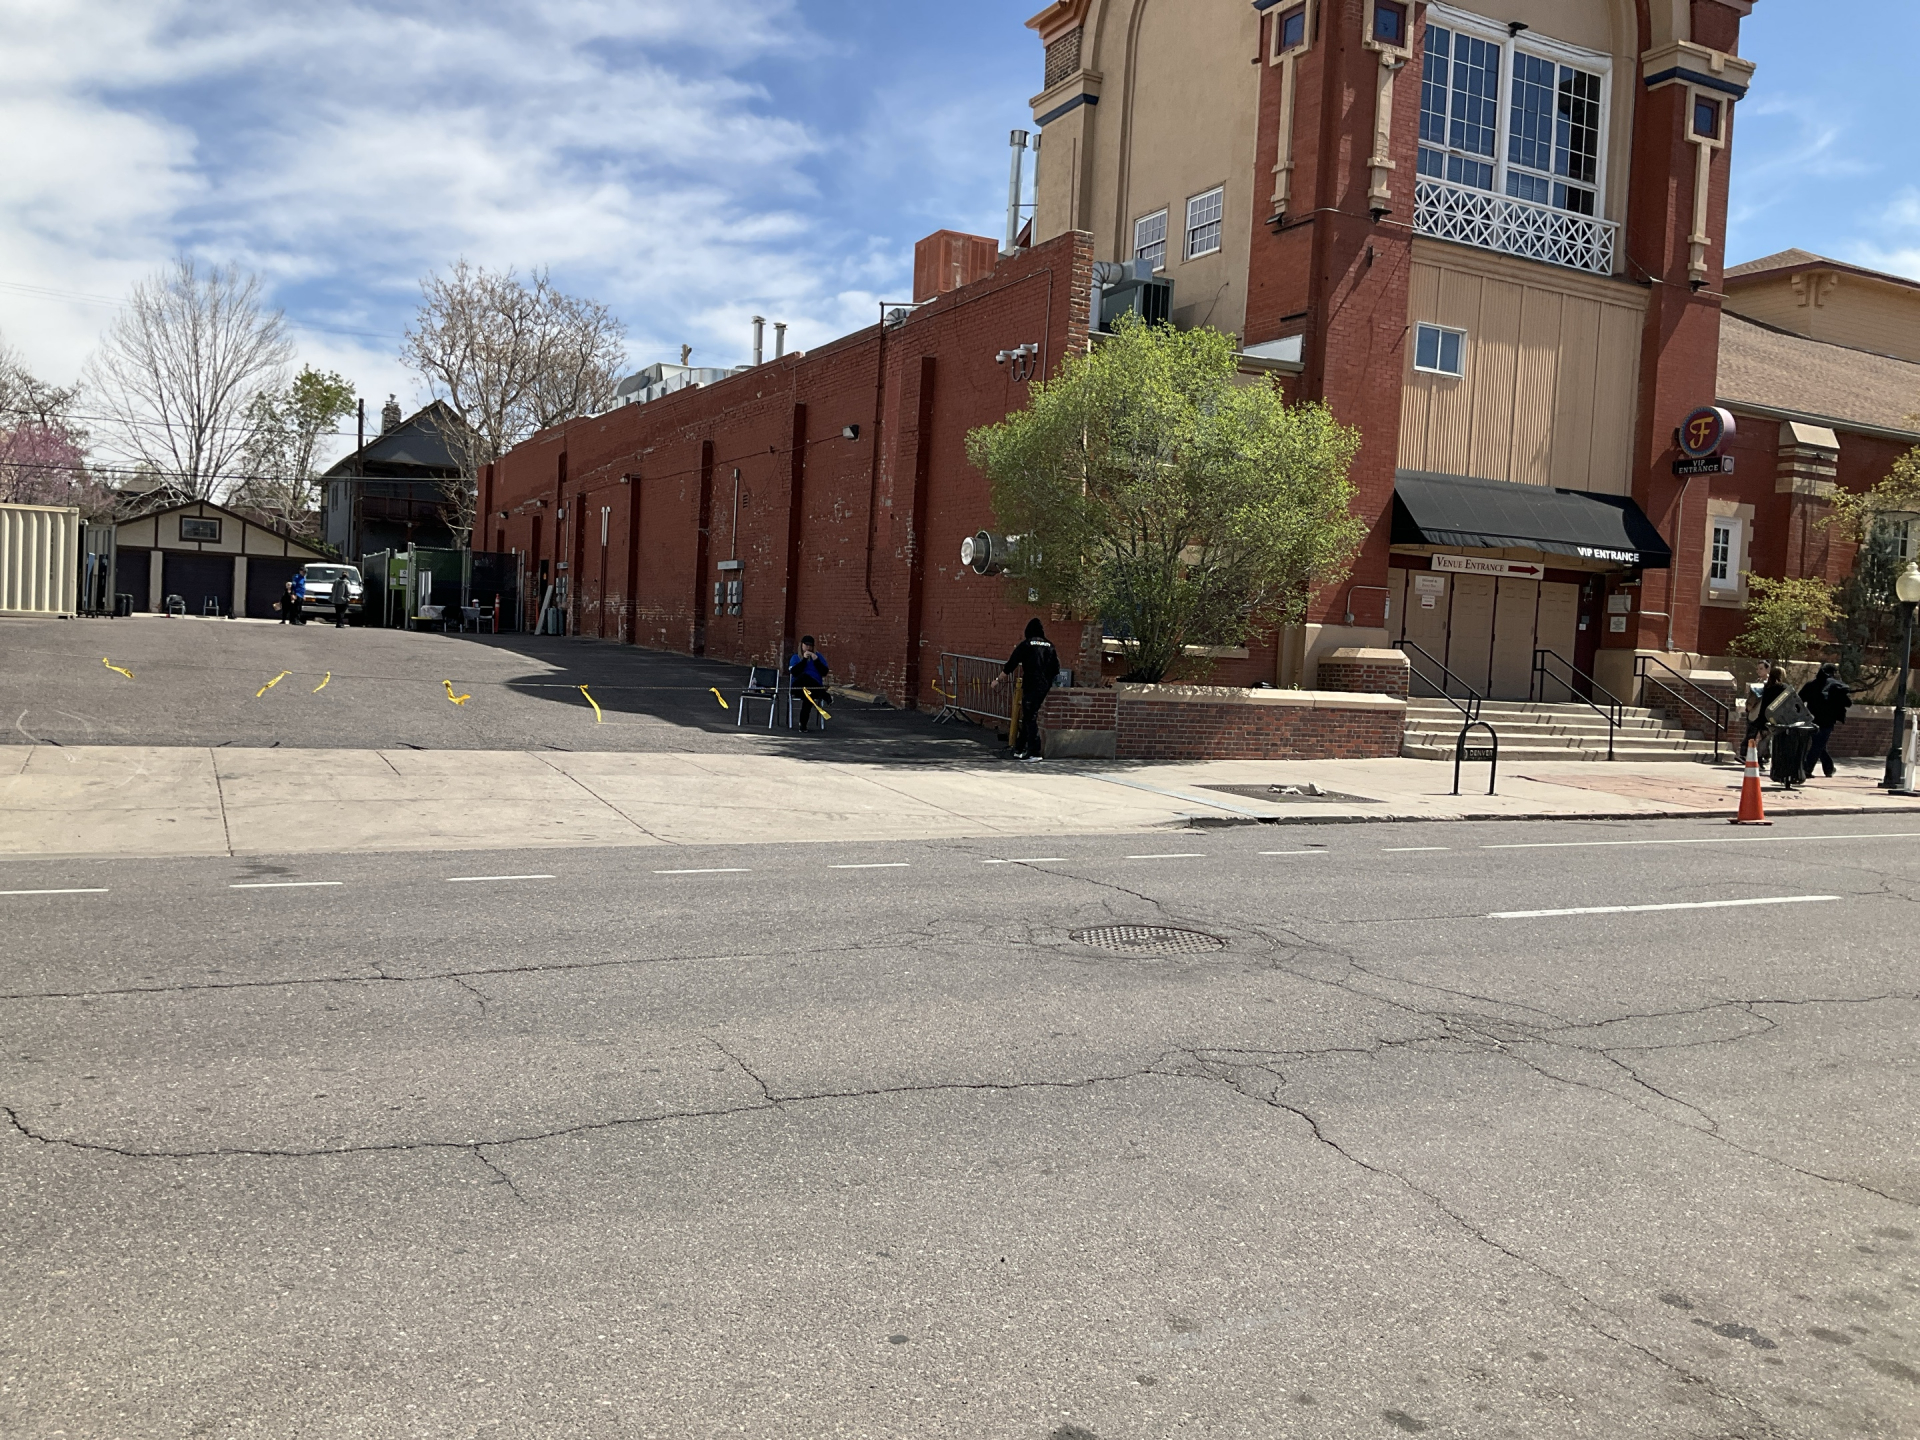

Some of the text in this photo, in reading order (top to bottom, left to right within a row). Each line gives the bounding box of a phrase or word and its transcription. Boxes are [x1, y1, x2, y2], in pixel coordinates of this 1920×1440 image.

[1690, 416, 1714, 449] F
[1678, 464, 1719, 474] ENTRANCE
[1577, 547, 1640, 562] VIP ENTRANCE
[1437, 557, 1504, 572] VENUE ENTRANCE
[1469, 749, 1493, 757] DENVER
